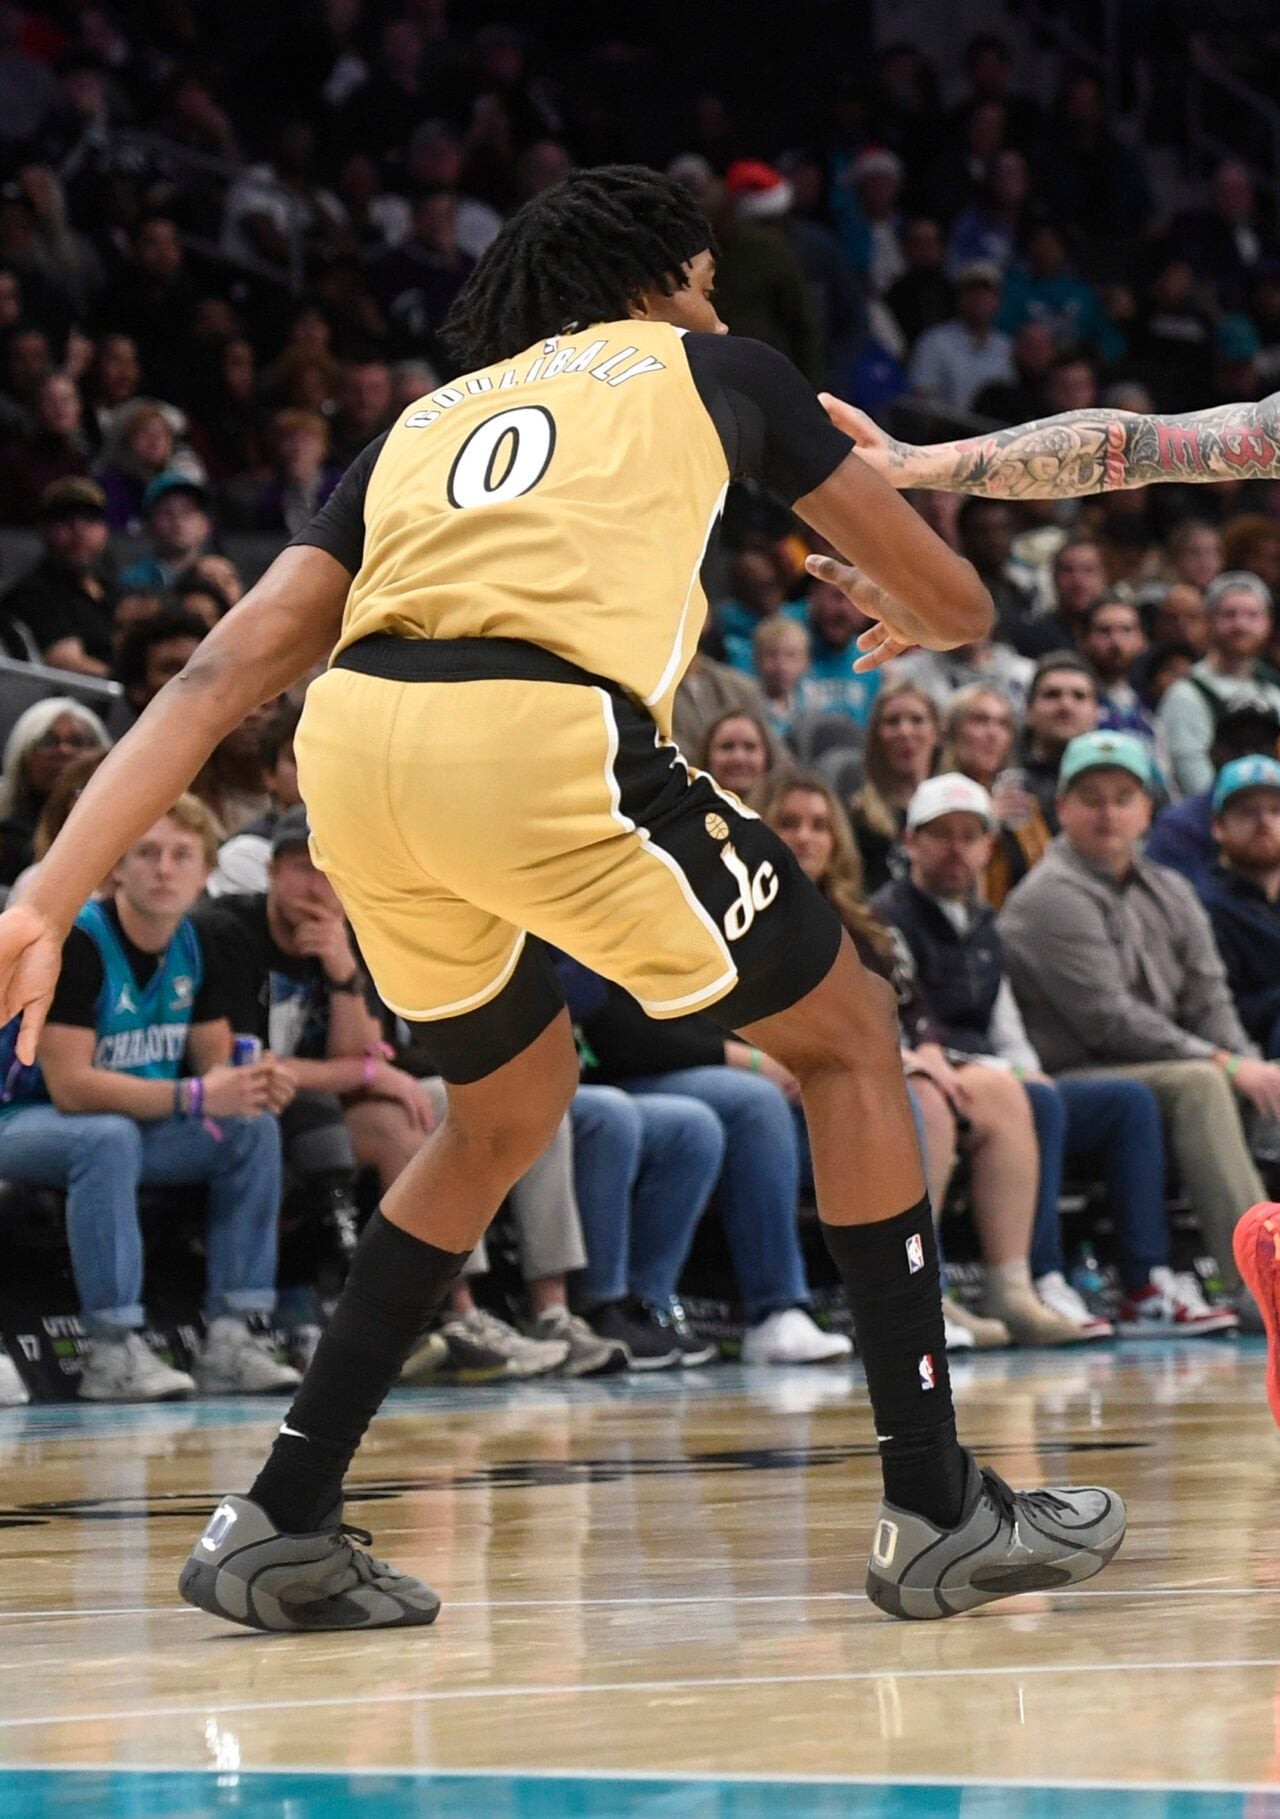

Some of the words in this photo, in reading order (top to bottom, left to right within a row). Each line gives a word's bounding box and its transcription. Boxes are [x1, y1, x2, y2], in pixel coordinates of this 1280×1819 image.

[405, 340, 666, 428] COULIBALY
[447, 405, 556, 509] 0
[873, 1518, 899, 1568] 0
